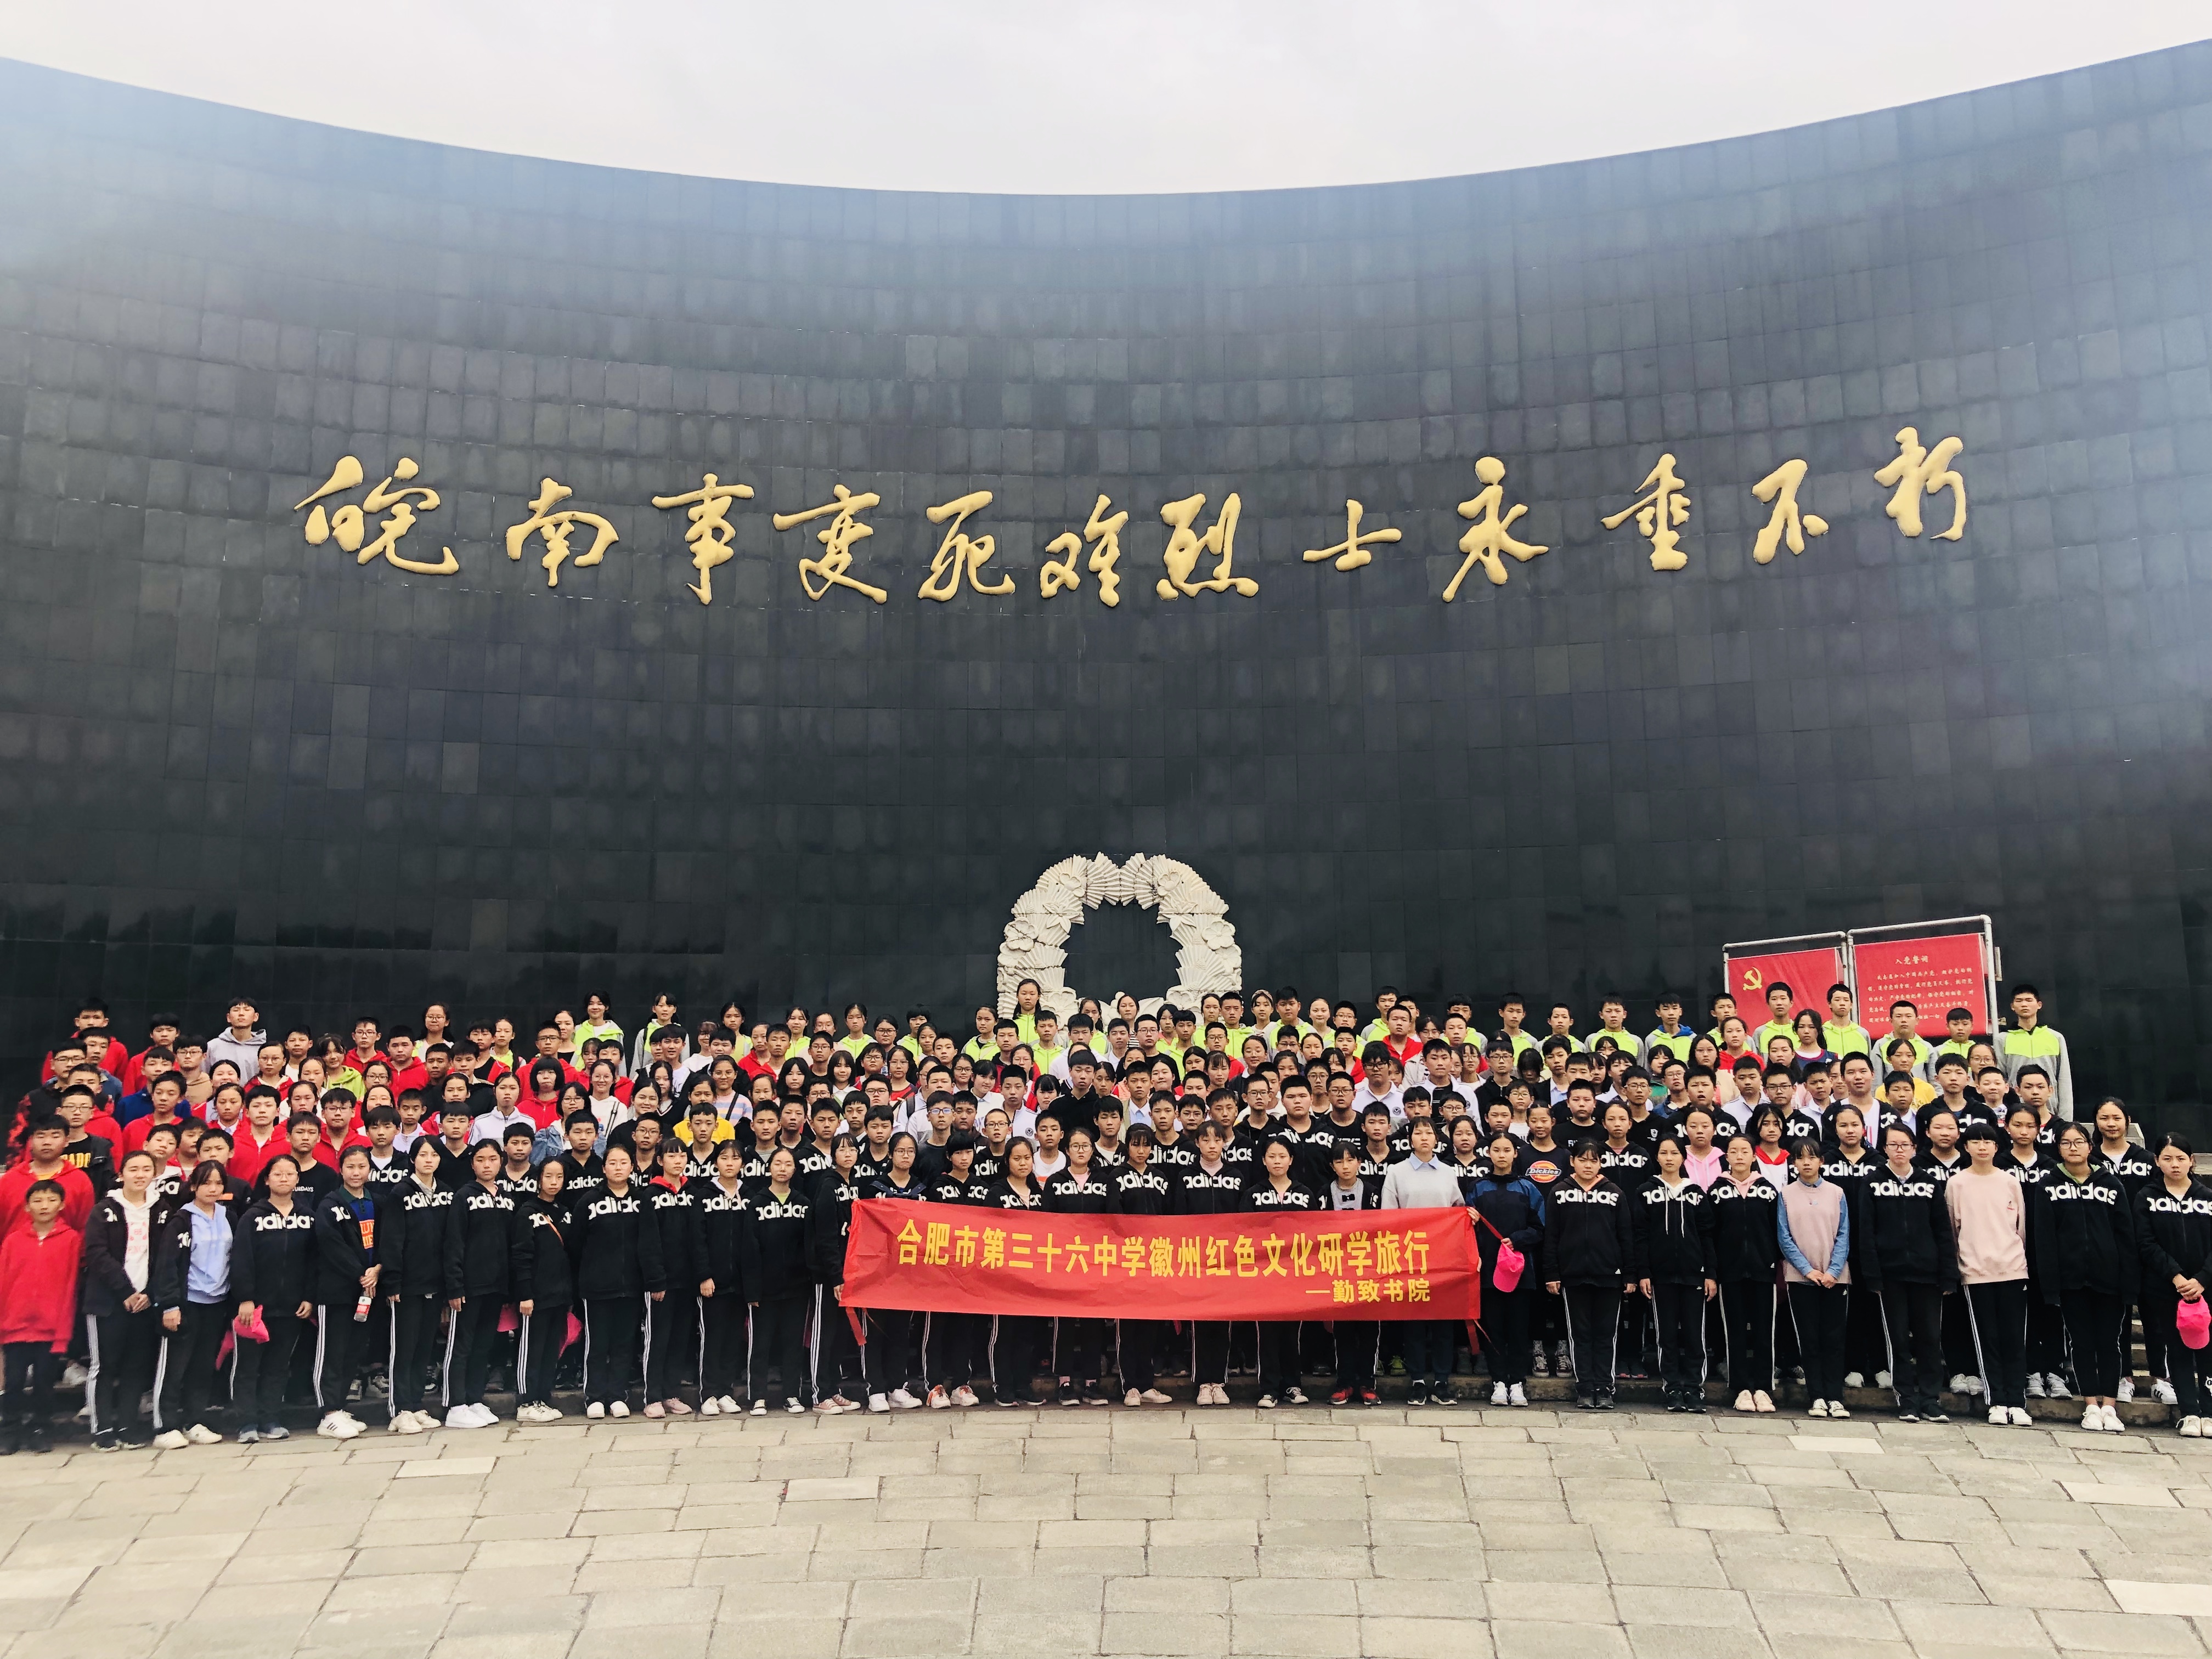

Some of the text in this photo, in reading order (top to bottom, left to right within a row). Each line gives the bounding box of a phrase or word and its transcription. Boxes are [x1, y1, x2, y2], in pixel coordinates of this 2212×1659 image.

[1183, 1173, 1241, 1190] adidas
[1555, 1188, 1619, 1206] adidas
[2045, 1182, 2117, 1205] adidas
[897, 1218, 1430, 1278] 合肥市第三十六中学徽州红色文化研学旅行
